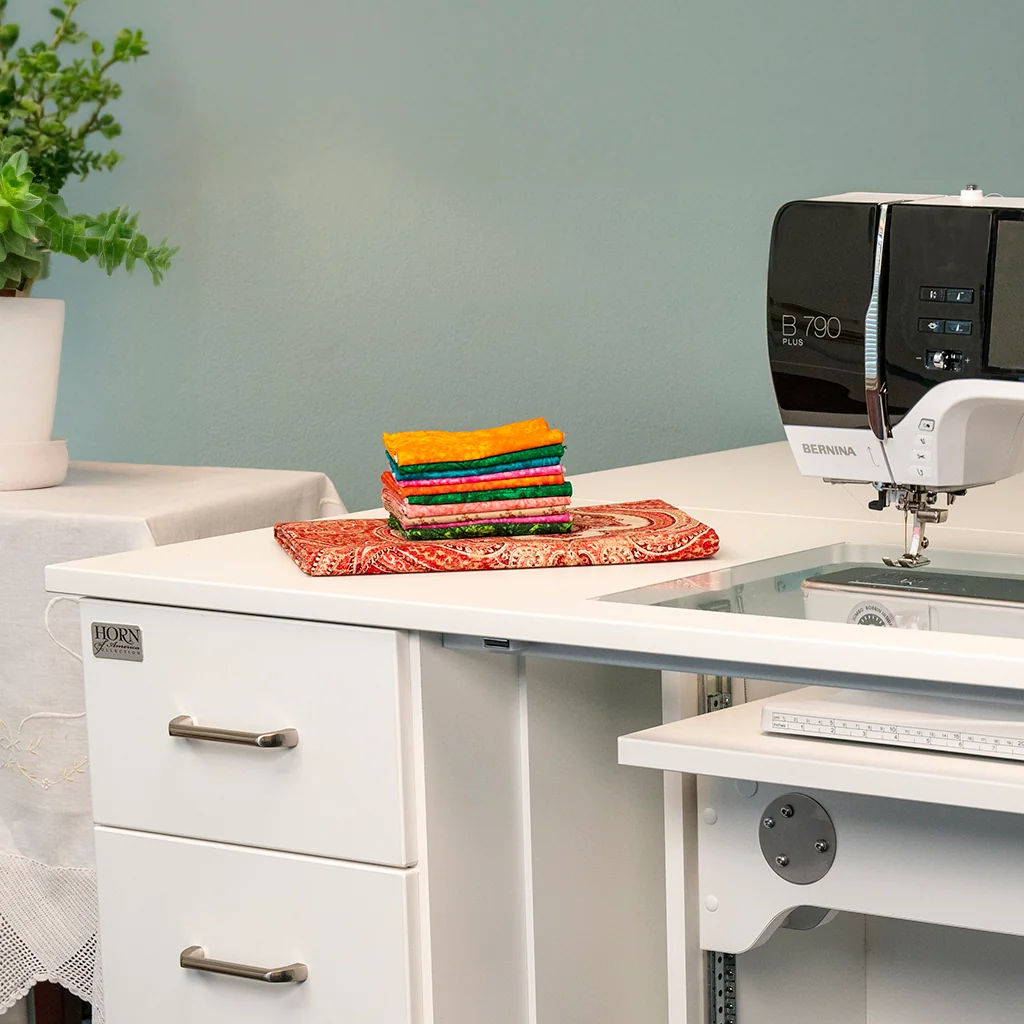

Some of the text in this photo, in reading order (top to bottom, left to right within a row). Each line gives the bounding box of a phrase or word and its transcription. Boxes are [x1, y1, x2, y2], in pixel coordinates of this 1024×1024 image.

[782, 314, 841, 339] B 790
[782, 338, 804, 346] PLUS
[802, 443, 857, 457] BERNINA
[852, 607, 864, 621] JUMBO
[865, 605, 882, 614] BOBBIN
[94, 625, 140, 645] HORN
